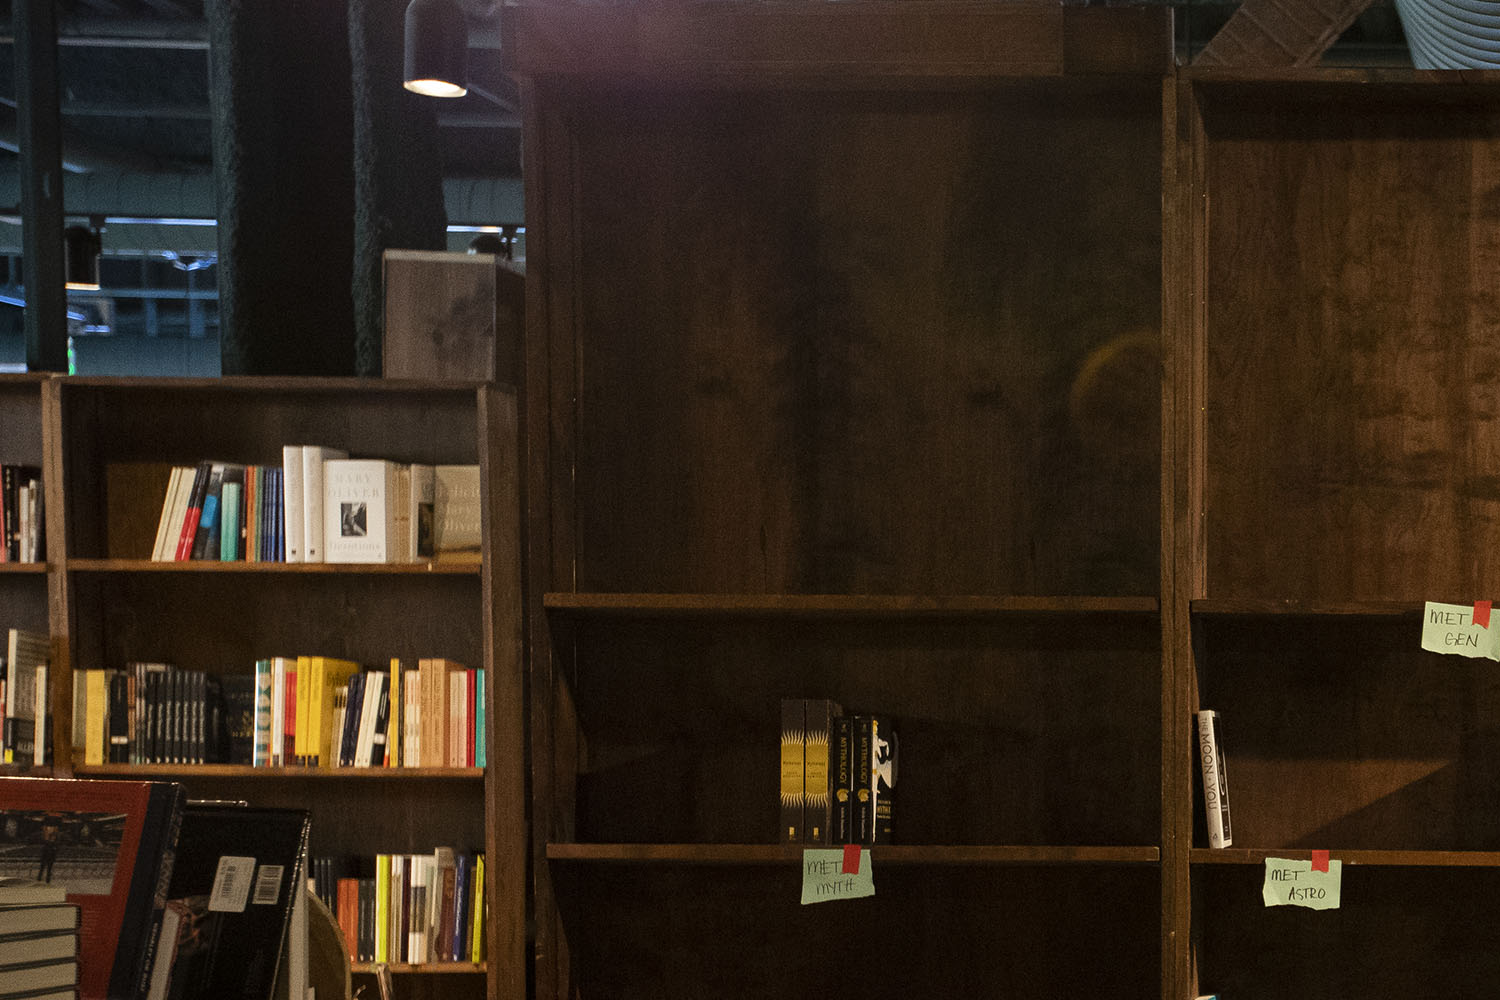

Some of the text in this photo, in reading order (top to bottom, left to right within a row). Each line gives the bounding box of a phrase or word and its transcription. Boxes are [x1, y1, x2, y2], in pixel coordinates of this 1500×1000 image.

[328, 487, 380, 498] OLIVER
[1430, 610, 1470, 626] MET
[1444, 633, 1478, 648] GEN
[1202, 733, 1214, 775] MOON
[1208, 783, 1217, 810] YOU
[807, 860, 843, 875] MET
[1271, 870, 1305, 881] MET
[816, 879, 855, 895] MYTH
[1289, 887, 1326, 900] ASTRO
